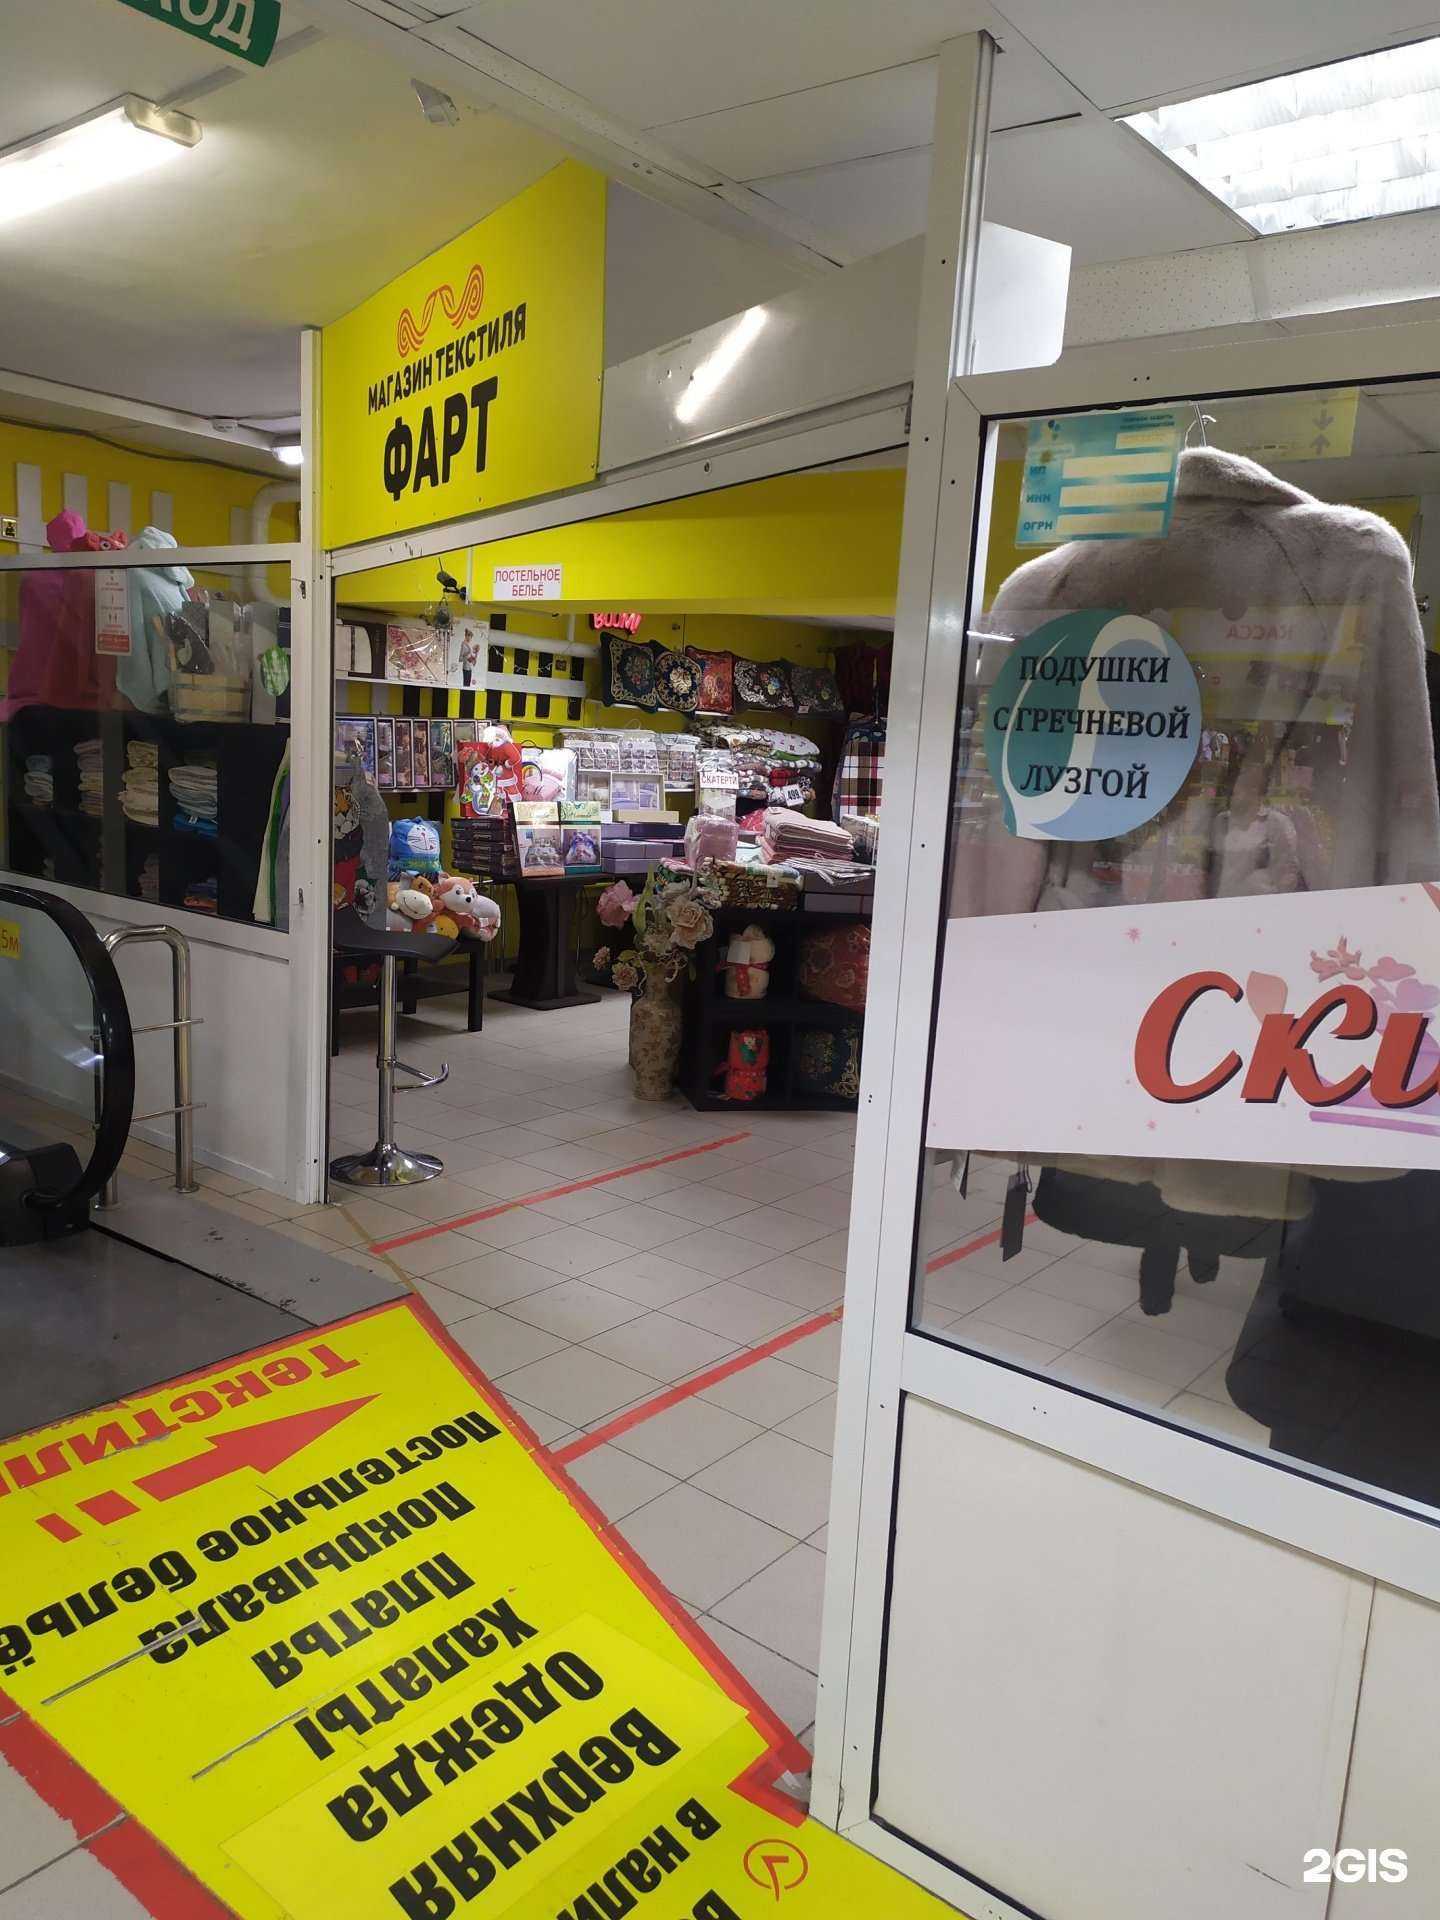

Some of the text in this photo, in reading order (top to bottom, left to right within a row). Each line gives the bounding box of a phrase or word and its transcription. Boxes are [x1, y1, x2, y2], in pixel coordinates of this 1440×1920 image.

[143, 0, 251, 51] ОД
[368, 302, 527, 415] МАГАЗИН ТЕКСТИЛЯ
[384, 375, 499, 502] ФАРТ
[494, 569, 561, 583] ПОСТЕЛЬНОЕ
[1024, 522, 1053, 530] ОГРН
[512, 584, 544, 597] БЕЛЬЁ
[1020, 656, 1170, 686] ПОДУШКИ
[701, 775, 737, 785] СКАТЕРТИ
[1020, 764, 1148, 799] ЛУЗГОЙ
[0, 1411, 502, 1677] Постельное бельё
[137, 1481, 476, 1664] Покрывала
[251, 1551, 475, 1689] Платья
[293, 1597, 539, 1761] Халаты
[327, 1651, 604, 1843] Одежда
[388, 1707, 682, 1920] Верхняя
